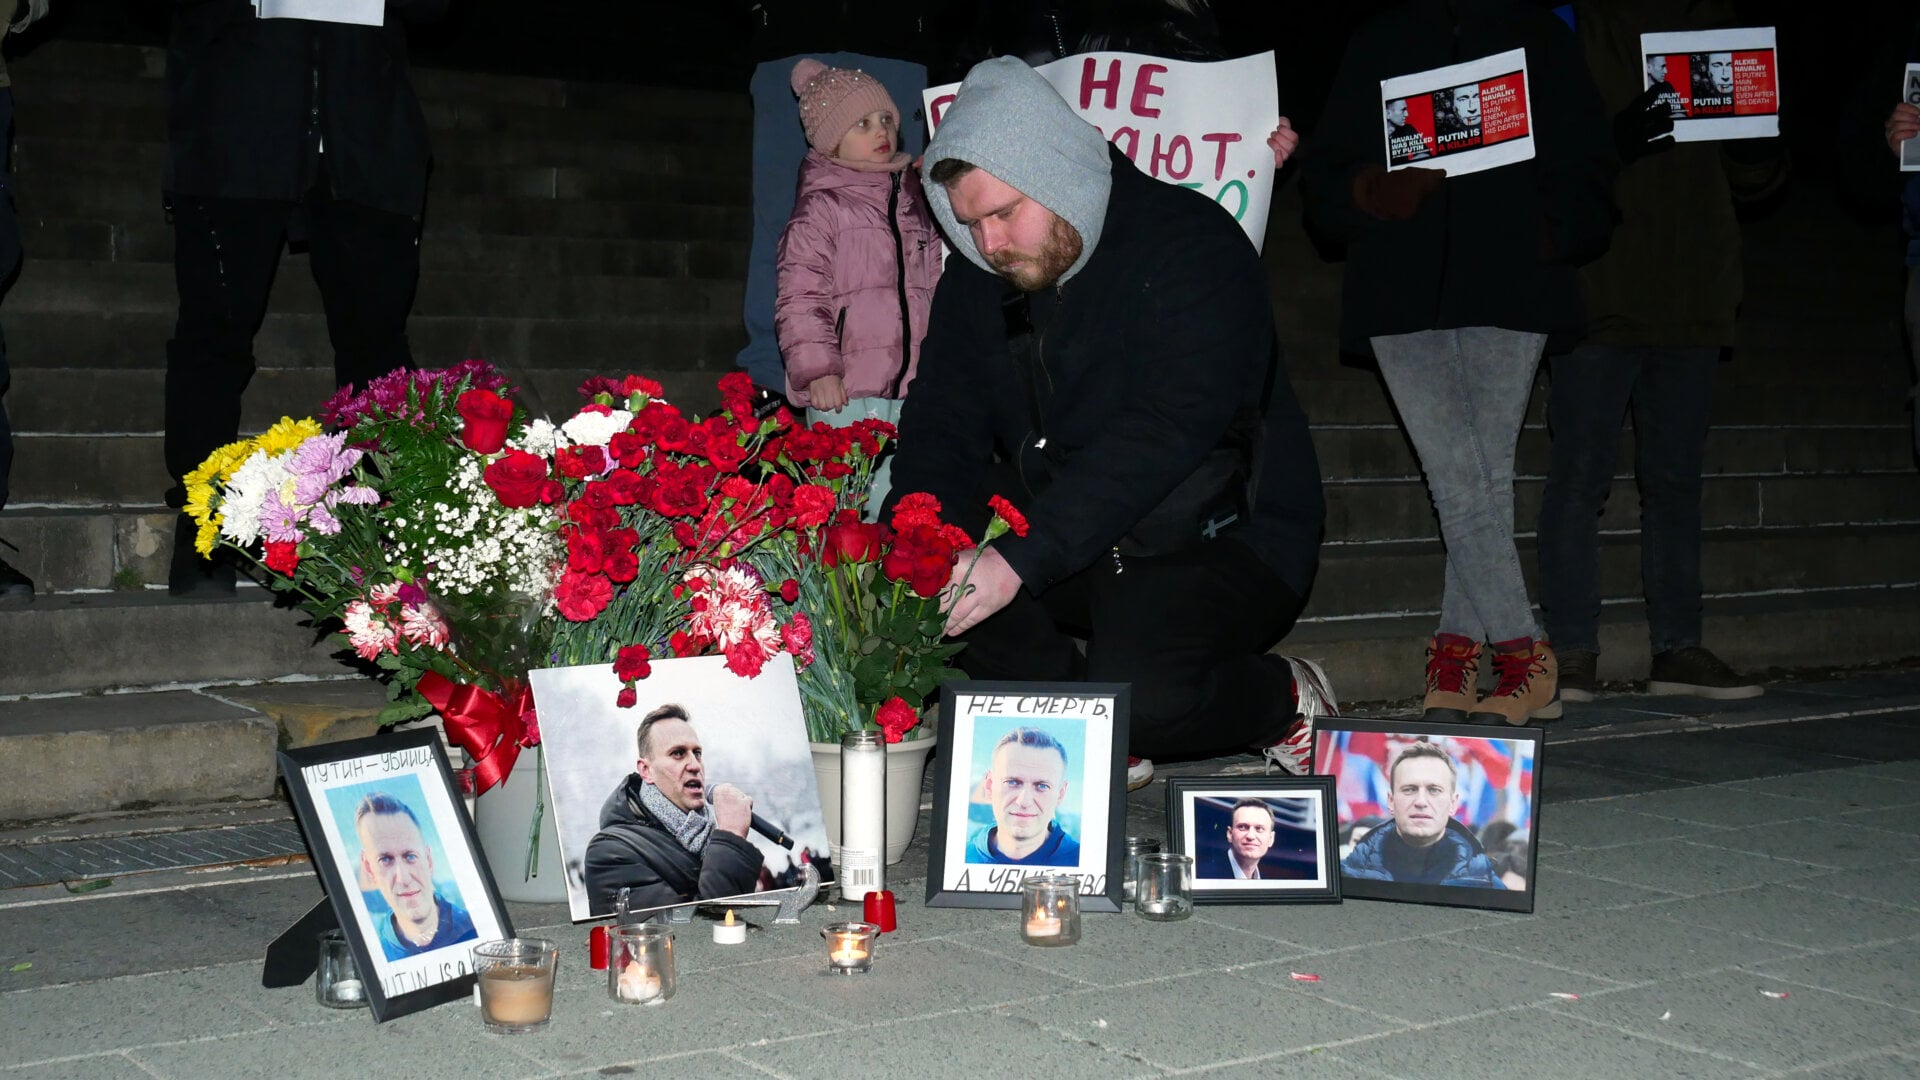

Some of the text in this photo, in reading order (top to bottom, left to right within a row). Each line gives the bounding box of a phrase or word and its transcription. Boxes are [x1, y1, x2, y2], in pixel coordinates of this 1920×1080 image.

[1080, 58, 1168, 118] НЕ
[1482, 84, 1506, 96] ALEXEI
[1482, 88, 1515, 102] NAVALNY
[1693, 96, 1732, 107] PUTIN IS
[1484, 106, 1500, 114] MAIN
[1484, 111, 1507, 122] ENEMY
[1484, 113, 1525, 128] EVEN AFTER
[1497, 121, 1520, 132] DEATH
[1392, 132, 1423, 143] NAVALNY
[1409, 137, 1432, 147] KILLED
[1437, 128, 1480, 144] PUTIN IS
[1403, 145, 1424, 153] PUTIN
[1438, 137, 1481, 152] A KILLER
[967, 696, 1006, 714] НЕ
[954, 868, 970, 892] А
